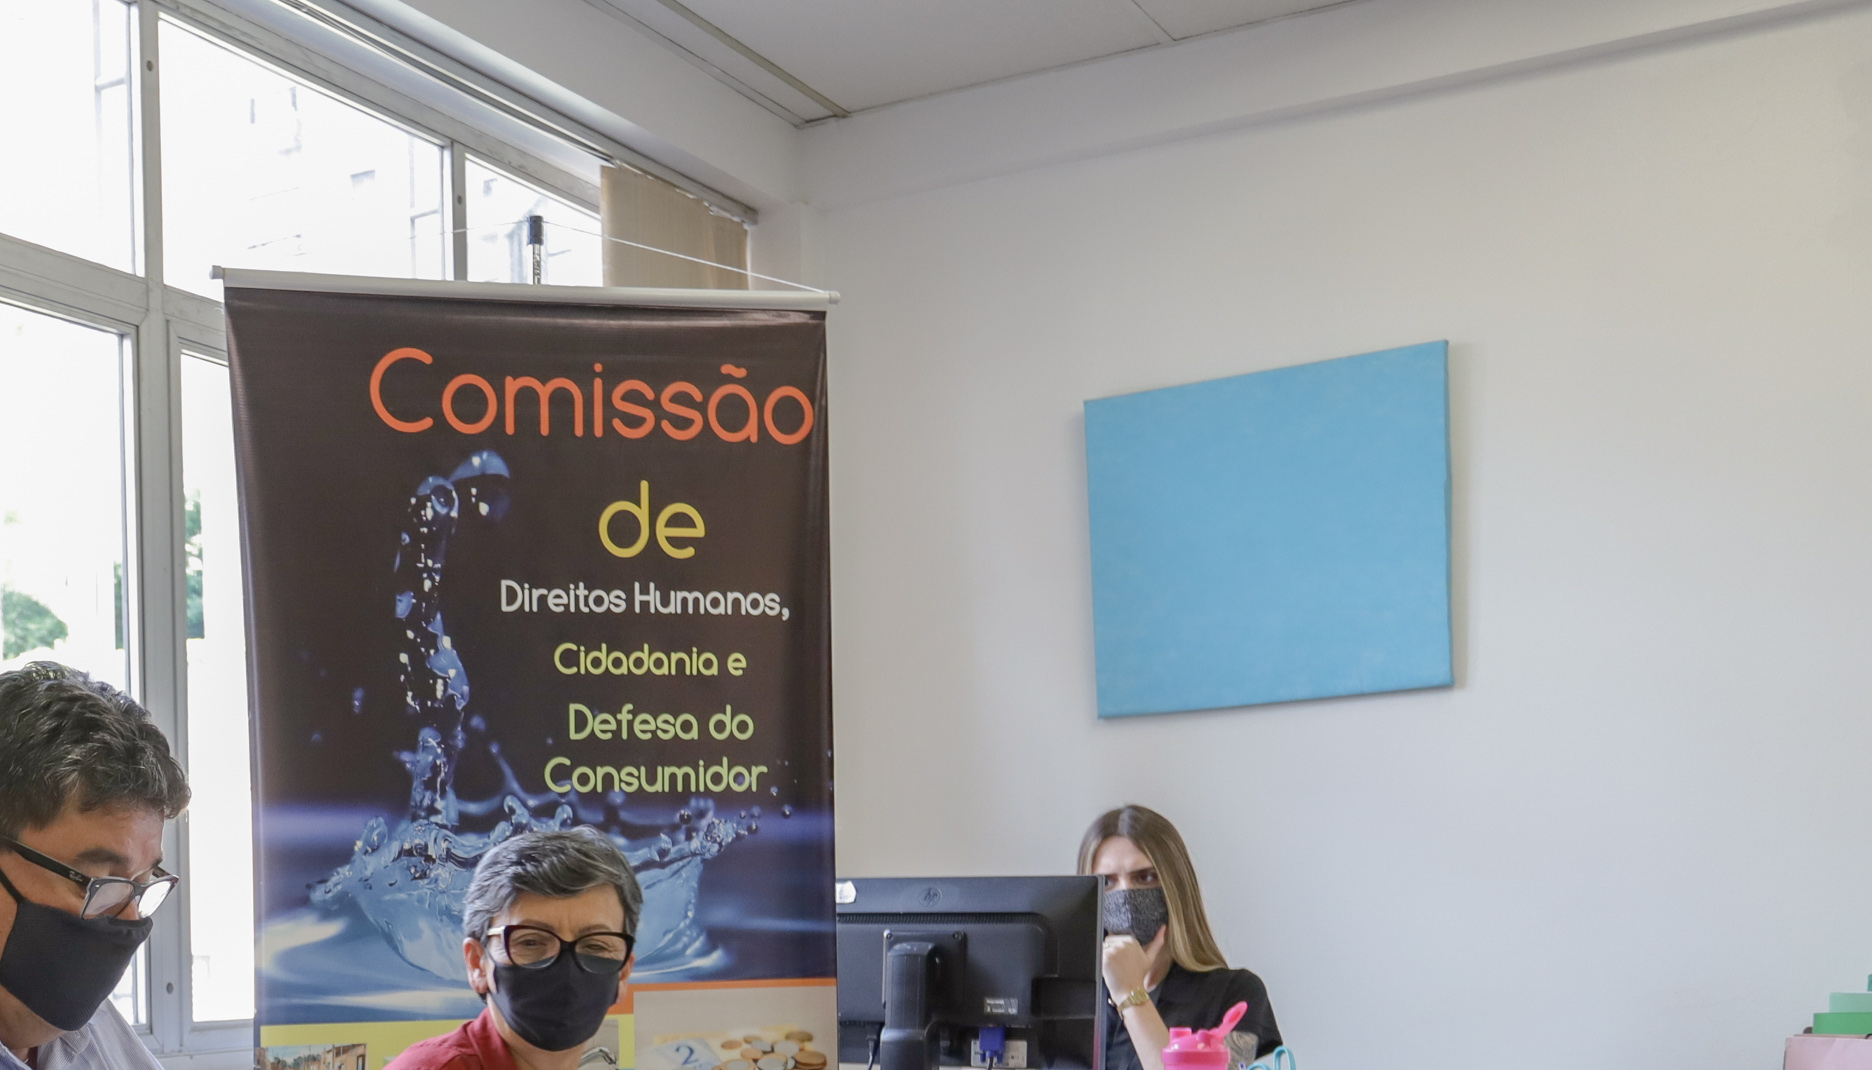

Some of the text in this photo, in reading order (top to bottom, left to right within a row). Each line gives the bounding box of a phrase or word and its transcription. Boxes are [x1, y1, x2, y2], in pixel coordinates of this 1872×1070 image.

[369, 346, 815, 445] Comissão
[598, 480, 706, 559] de
[500, 580, 790, 621] Direitos Humanos,
[553, 643, 747, 676] Cidadania e
[568, 703, 754, 741] Defesa do
[544, 756, 768, 794] Consumidor
[675, 1043, 699, 1066] 2
